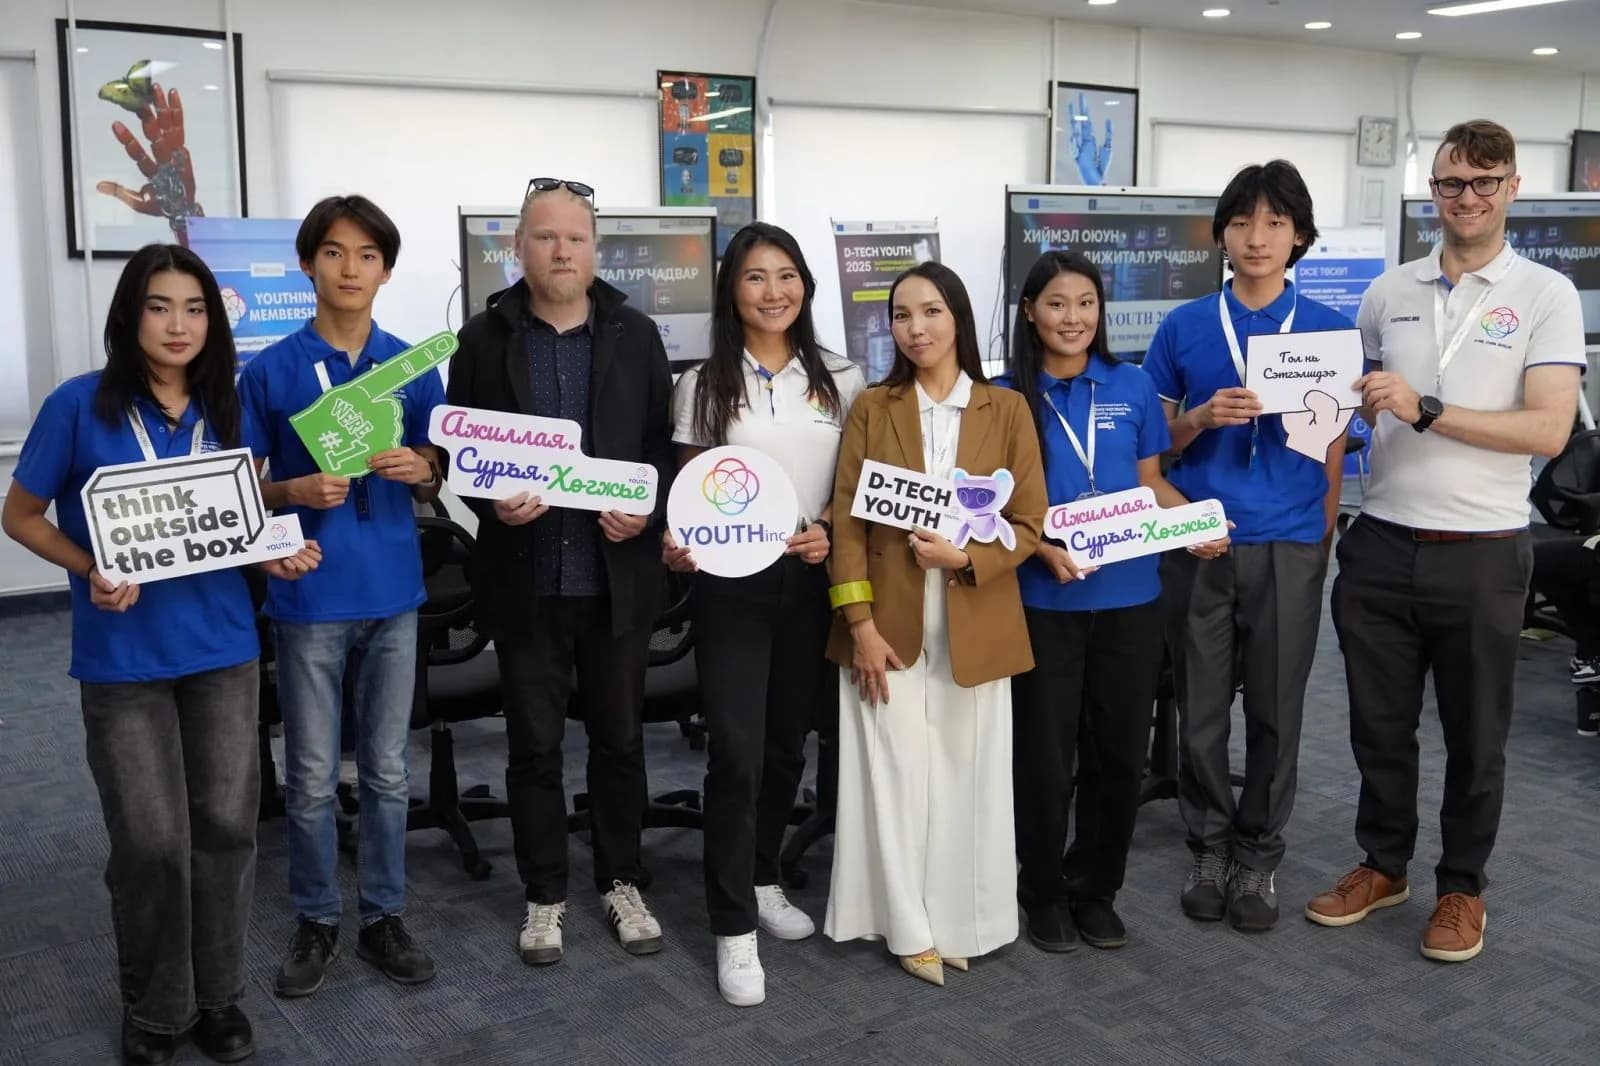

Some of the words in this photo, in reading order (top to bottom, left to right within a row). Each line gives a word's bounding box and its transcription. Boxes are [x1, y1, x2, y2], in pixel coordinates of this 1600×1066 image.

[1023, 226, 1079, 243] ХИЙМЭЛ
[1081, 229, 1120, 242] ОЮУН
[843, 246, 879, 258] D-TECH
[880, 245, 912, 257] YOUTH
[845, 261, 872, 272] 2025
[1147, 250, 1162, 263] УР
[1163, 250, 1209, 265] ЧАДВАР
[628, 268, 645, 281] УР
[646, 267, 699, 282] ЧАДВАР
[441, 410, 575, 451] Ажиллая.
[102, 485, 198, 520] think
[867, 471, 952, 507] D-TECH
[110, 506, 239, 546] outside
[863, 494, 940, 530] YOUTH
[1051, 499, 1153, 530] Ажиллая.
[115, 547, 175, 574] the
[183, 534, 248, 563] box
